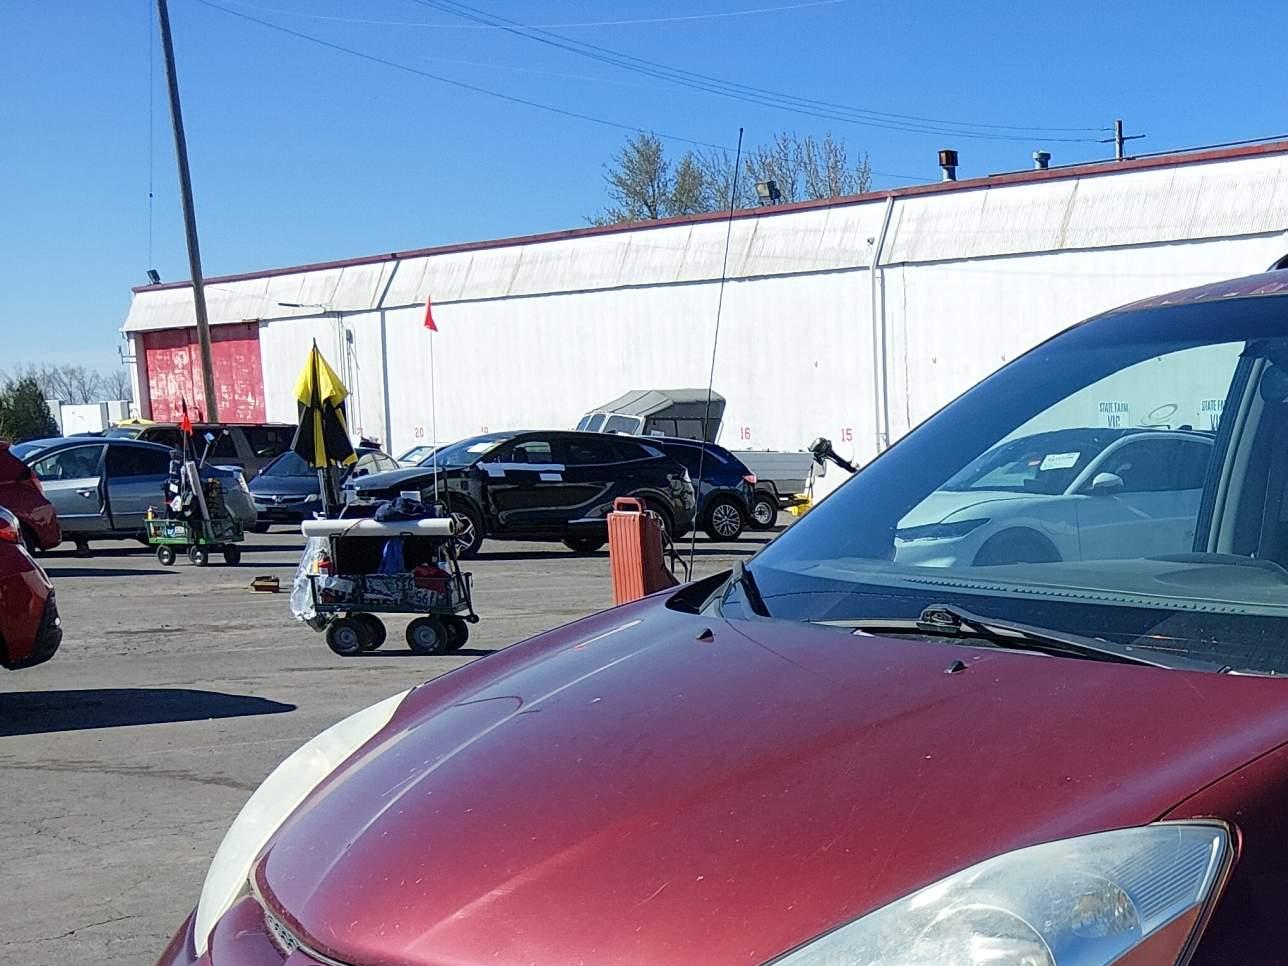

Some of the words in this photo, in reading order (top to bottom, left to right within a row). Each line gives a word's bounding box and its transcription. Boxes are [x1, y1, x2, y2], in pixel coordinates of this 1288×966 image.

[1107, 415, 1121, 428] VIC
[414, 426, 425, 439] 20
[740, 426, 751, 440] 16
[841, 427, 853, 442] 15
